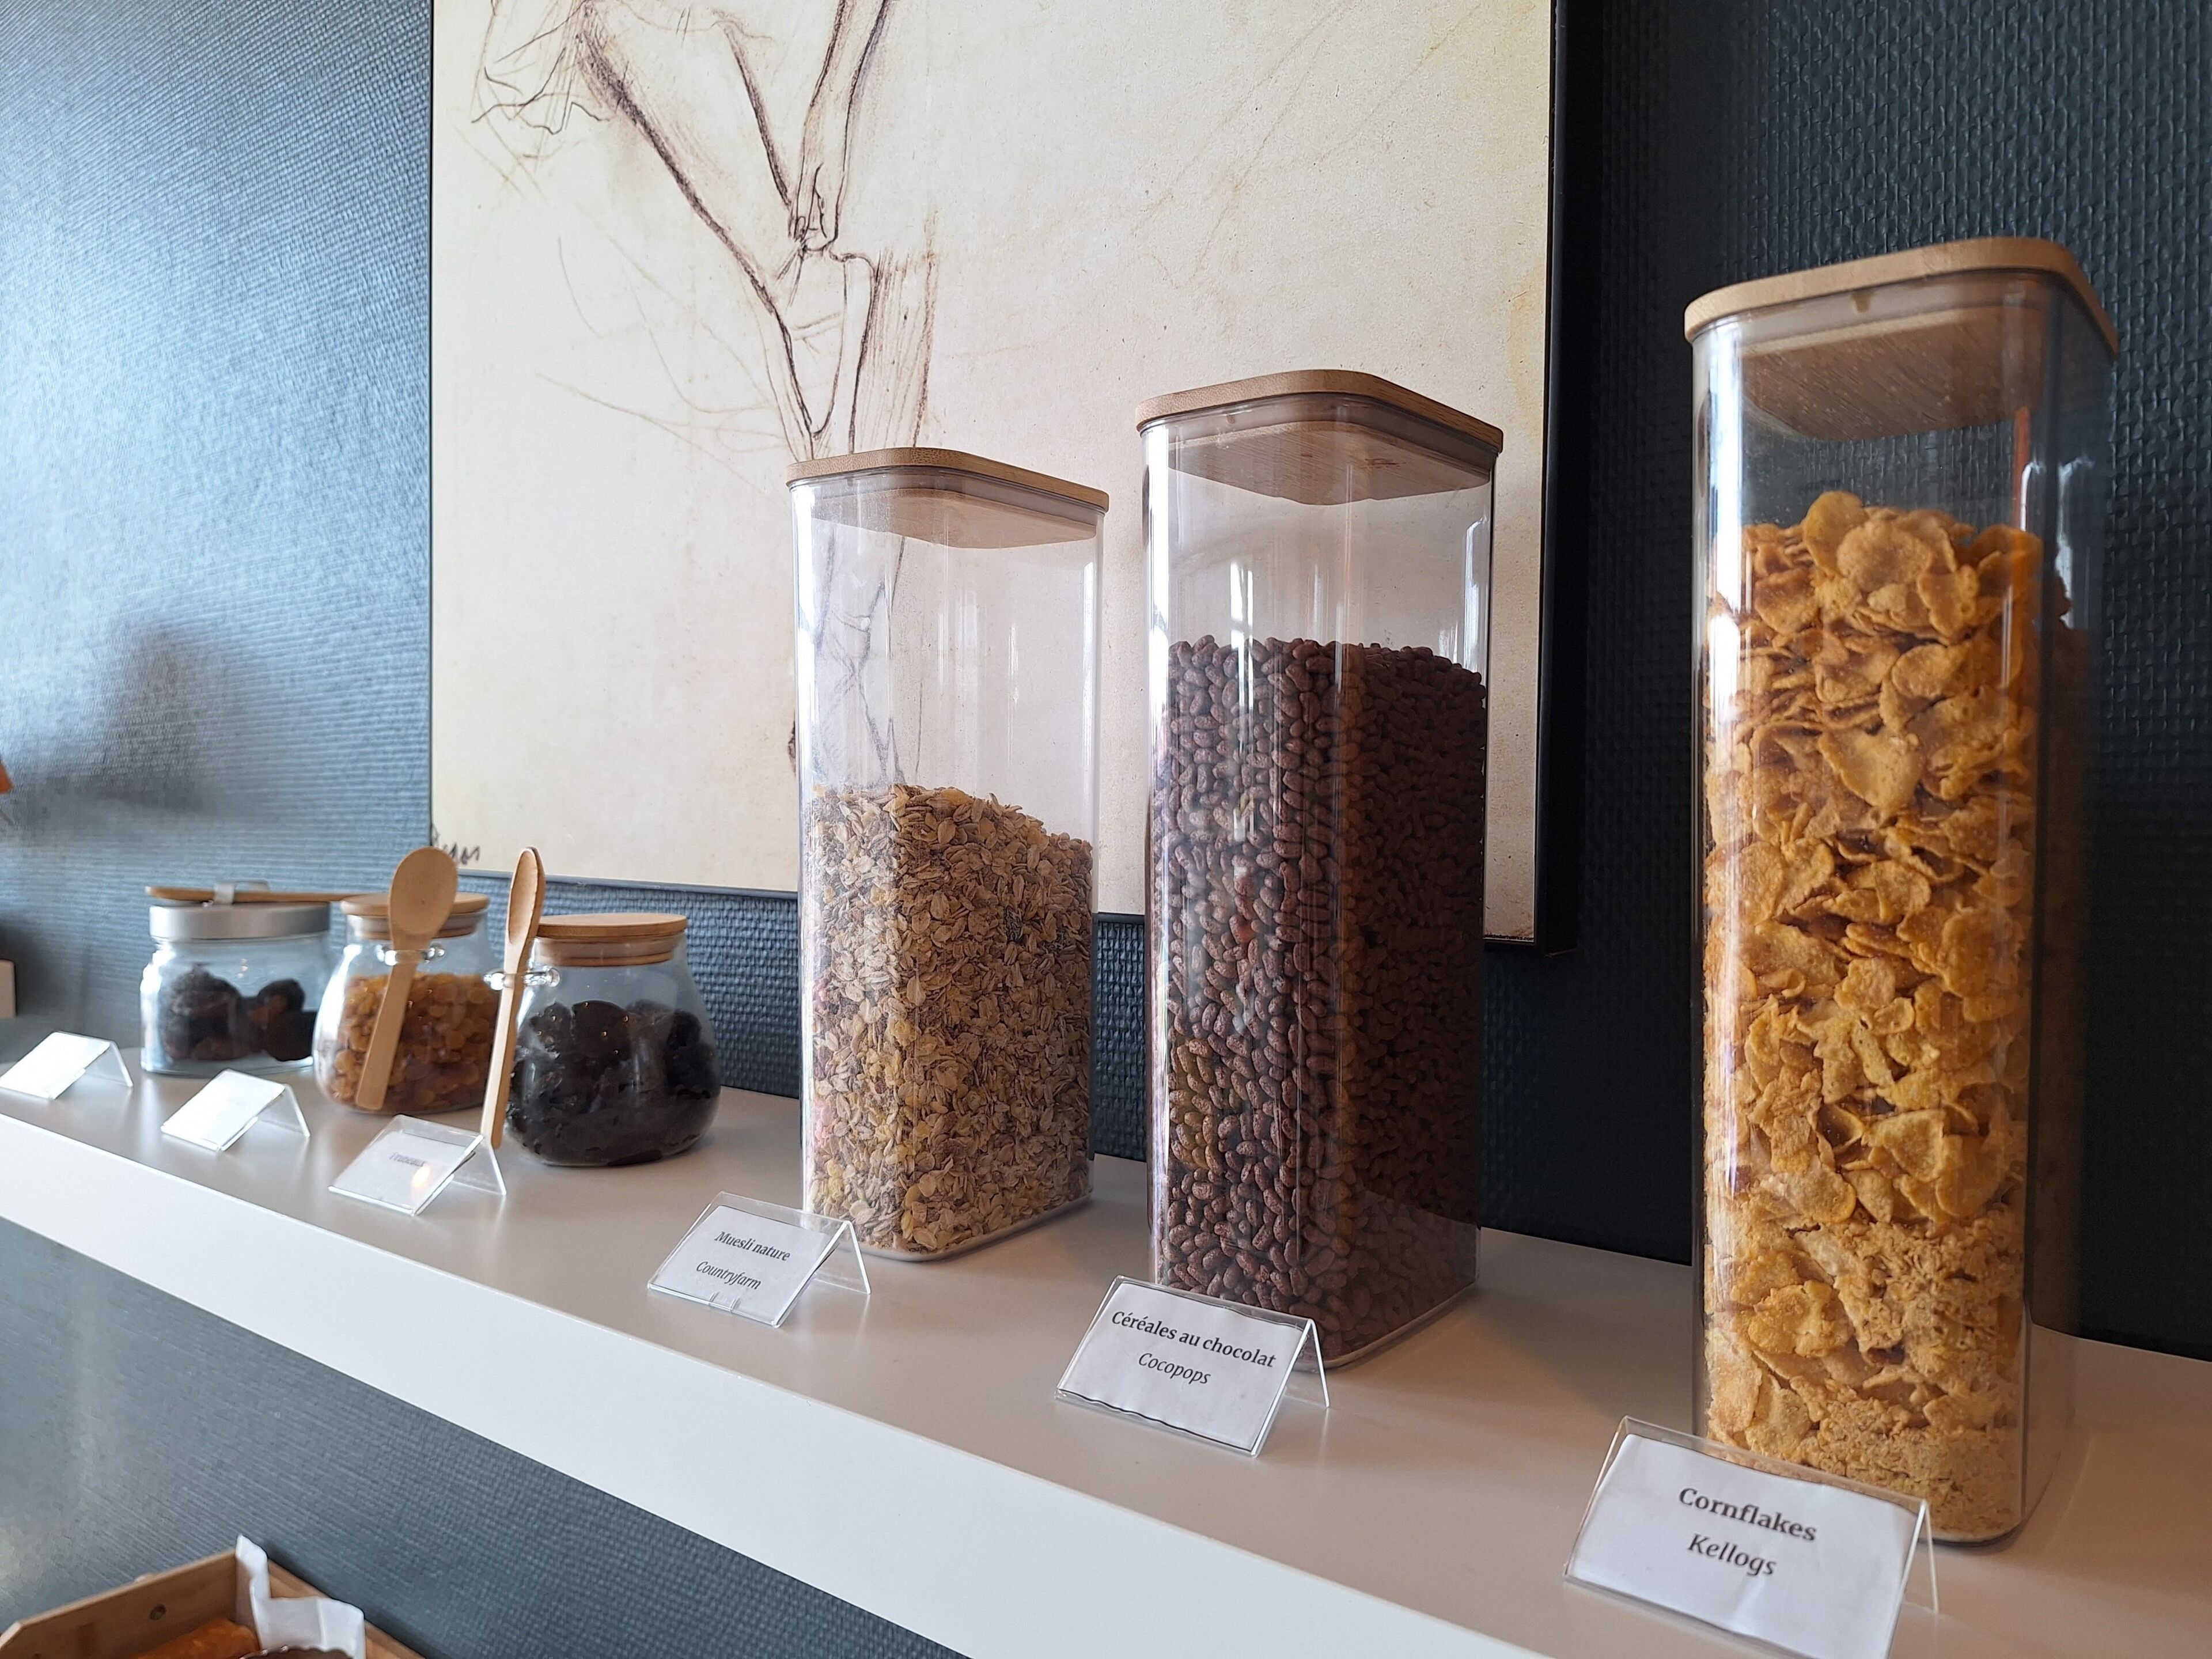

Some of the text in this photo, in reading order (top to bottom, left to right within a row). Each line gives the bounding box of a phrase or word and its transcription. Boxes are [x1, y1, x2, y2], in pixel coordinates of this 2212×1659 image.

[714, 1231, 790, 1262] Muesli nature
[696, 1261, 762, 1290] Countryfarm
[1112, 1310, 1276, 1368] Céréales au chocolat
[1138, 1353, 1211, 1384] Cocopops
[1679, 1487, 1817, 1541] Cornflakes
[1687, 1533, 1777, 1577] Kellogs
